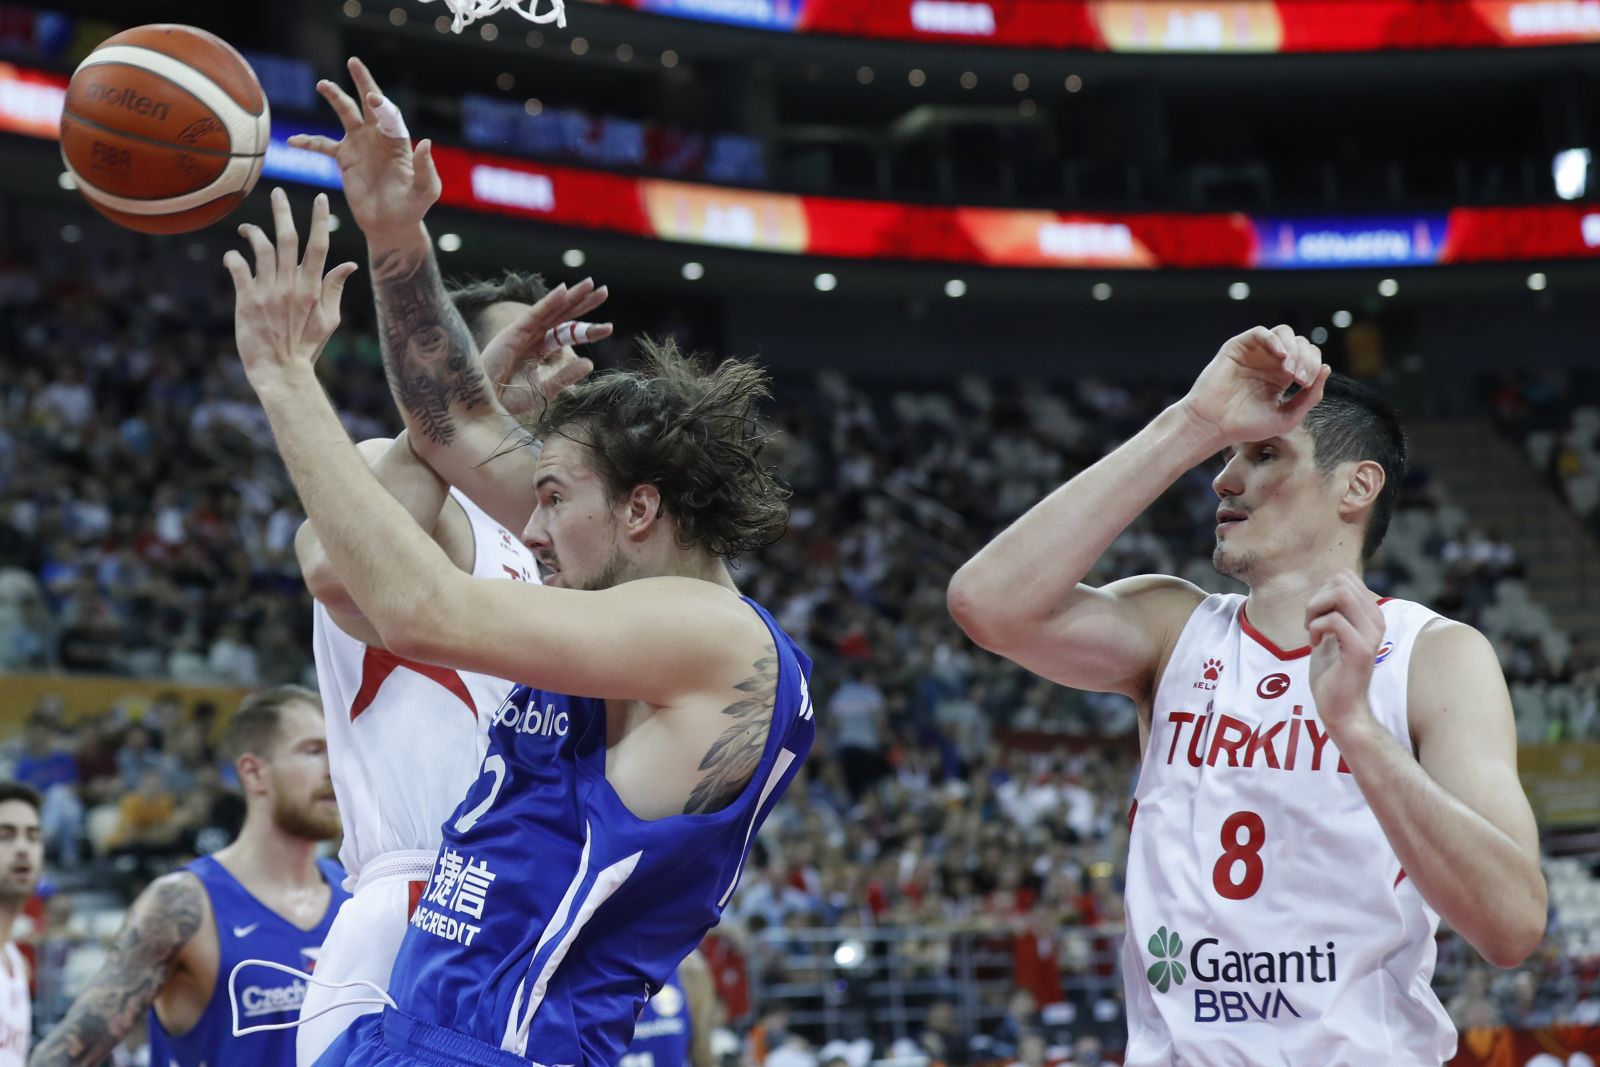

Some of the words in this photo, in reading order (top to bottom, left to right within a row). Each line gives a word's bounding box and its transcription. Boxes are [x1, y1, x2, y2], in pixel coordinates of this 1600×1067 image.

[86, 82, 171, 121] molten
[1212, 810, 1266, 900] 8
[1190, 937, 1336, 984] Garanti
[242, 978, 307, 1012] Czech
[1194, 987, 1303, 1023] BBVA
